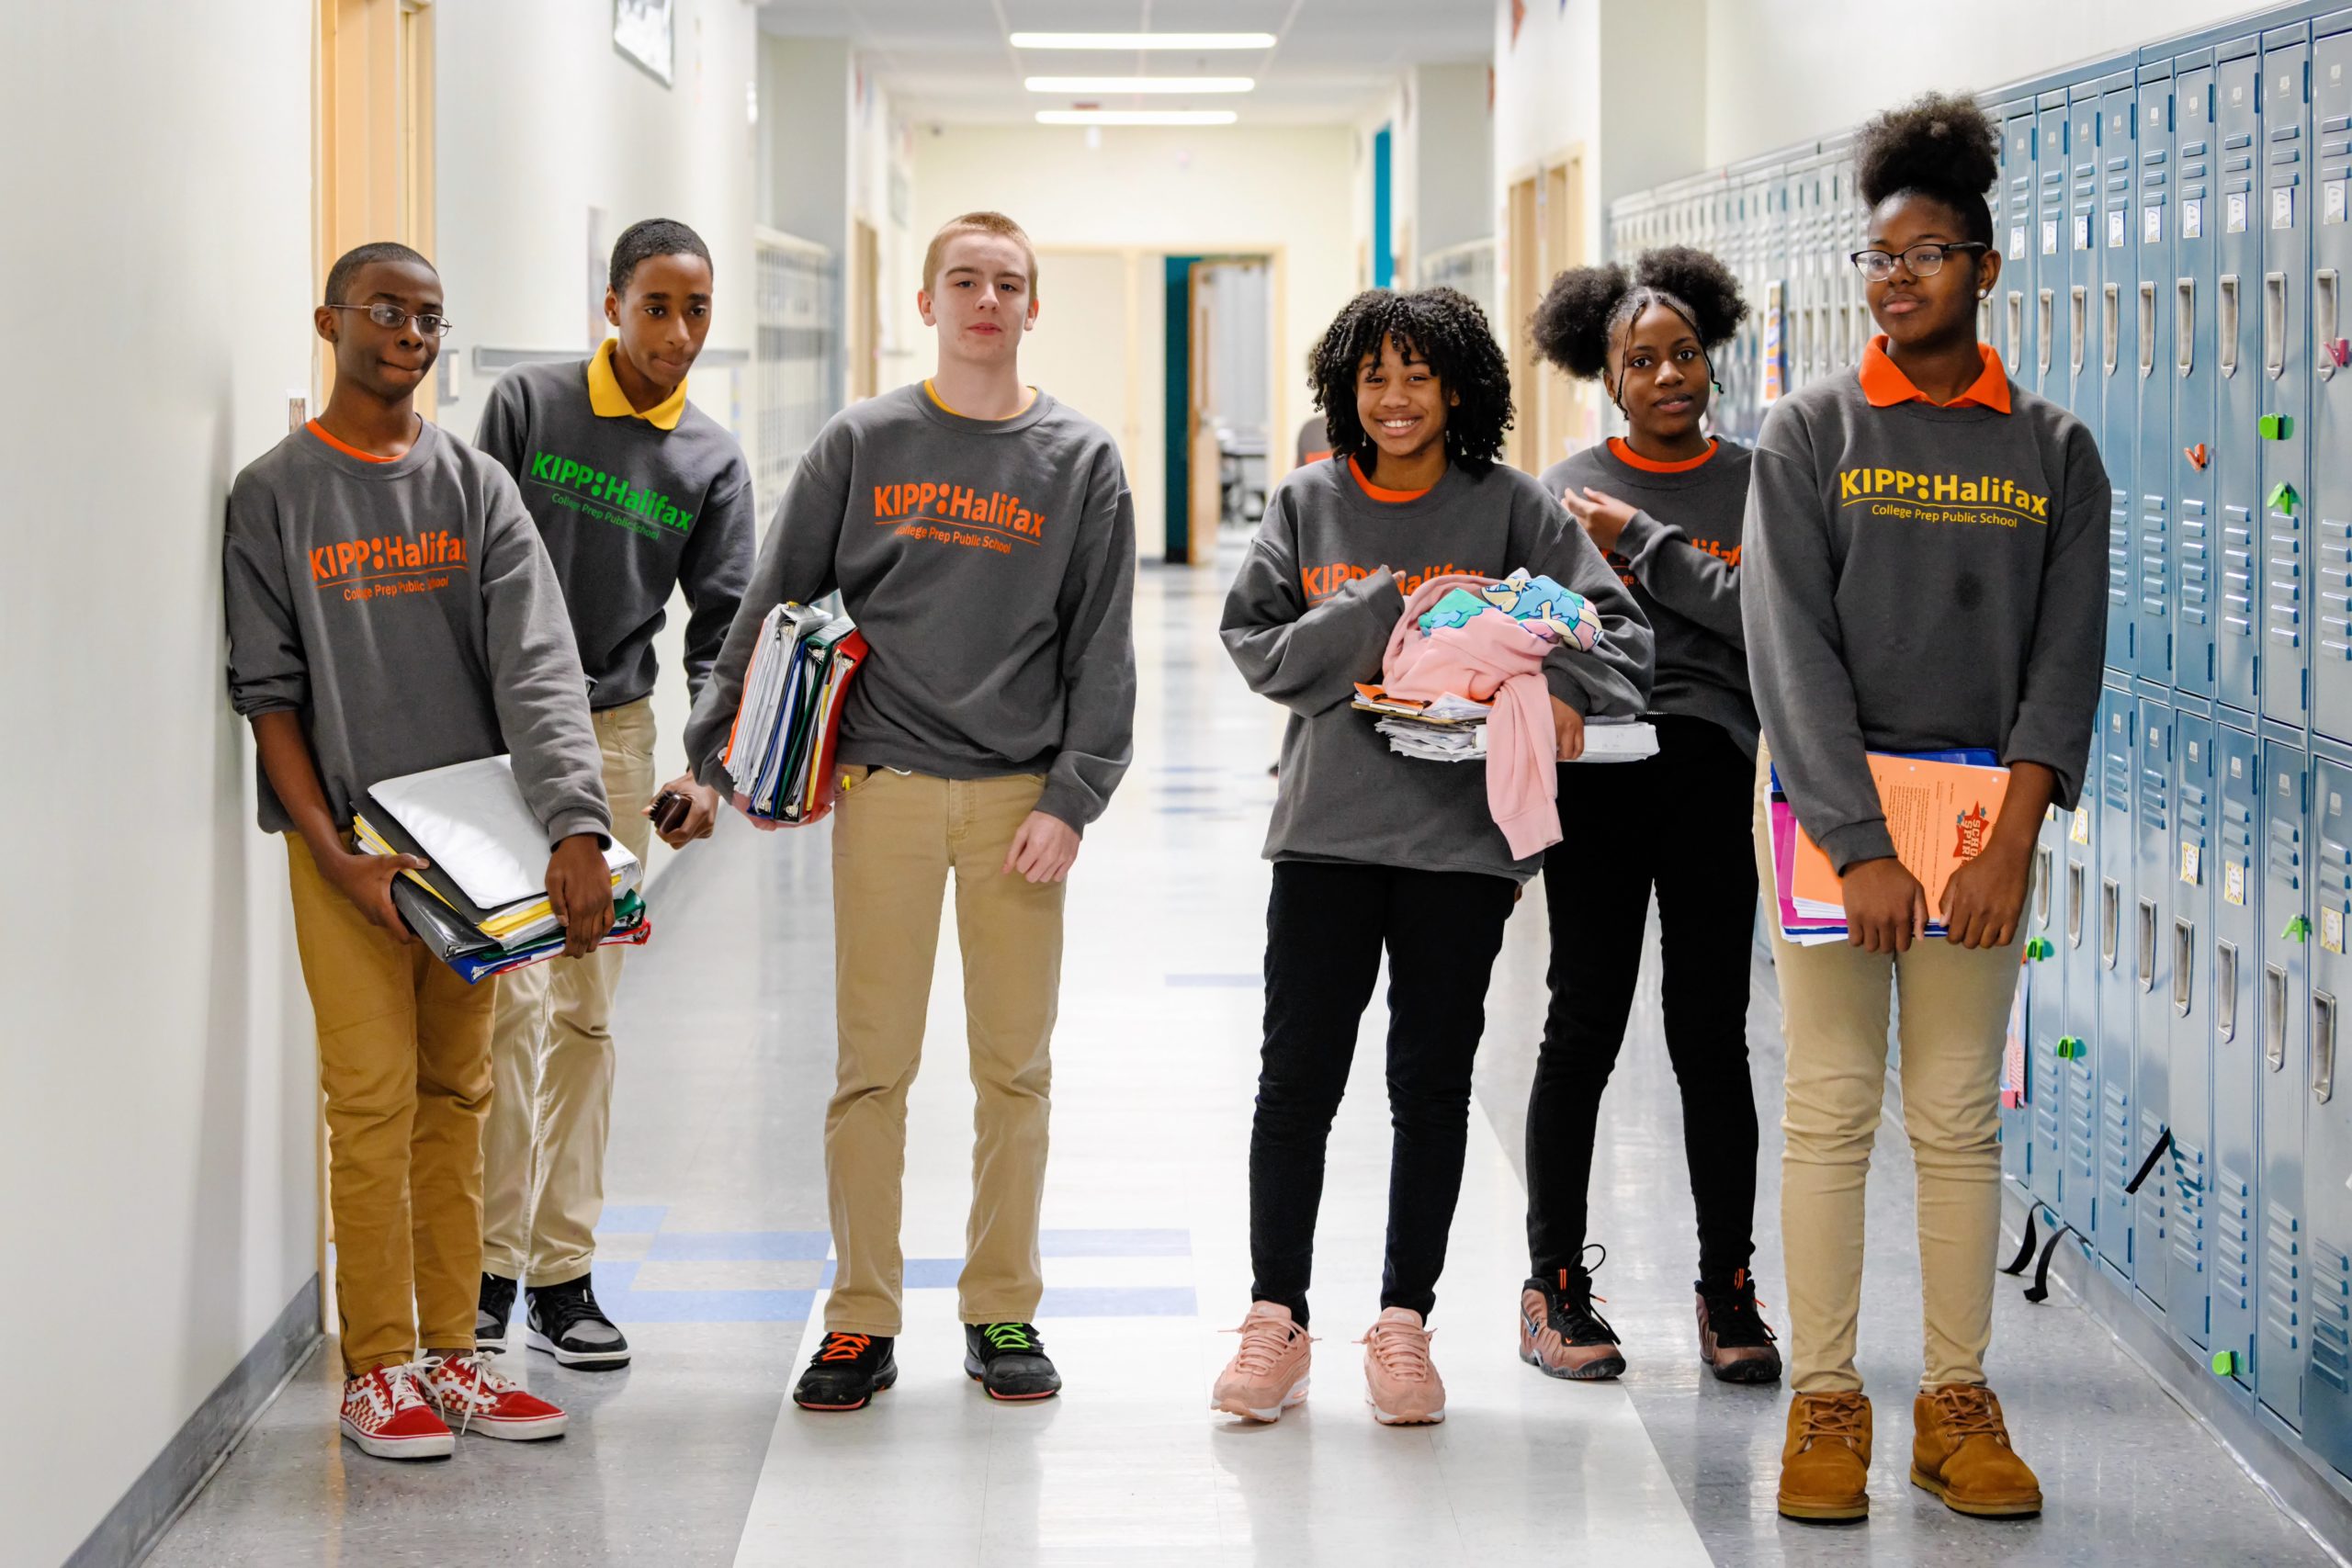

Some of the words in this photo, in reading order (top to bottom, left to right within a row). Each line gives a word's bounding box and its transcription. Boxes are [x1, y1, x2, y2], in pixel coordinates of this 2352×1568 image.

[551, 492, 581, 511] Coll
[1871, 504, 1912, 519] College
[1915, 508, 1940, 523] Prep
[1942, 512, 1977, 524] Public
[1980, 513, 2018, 528] School
[928, 526, 951, 545] Prep
[953, 530, 981, 547] Public
[981, 535, 1011, 554] School
[344, 587, 372, 602] Colle
[374, 583, 398, 598] Prep
[426, 575, 449, 591] hool
[1961, 819, 1973, 863] SPIRI
[1970, 818, 1981, 861] SCHO
